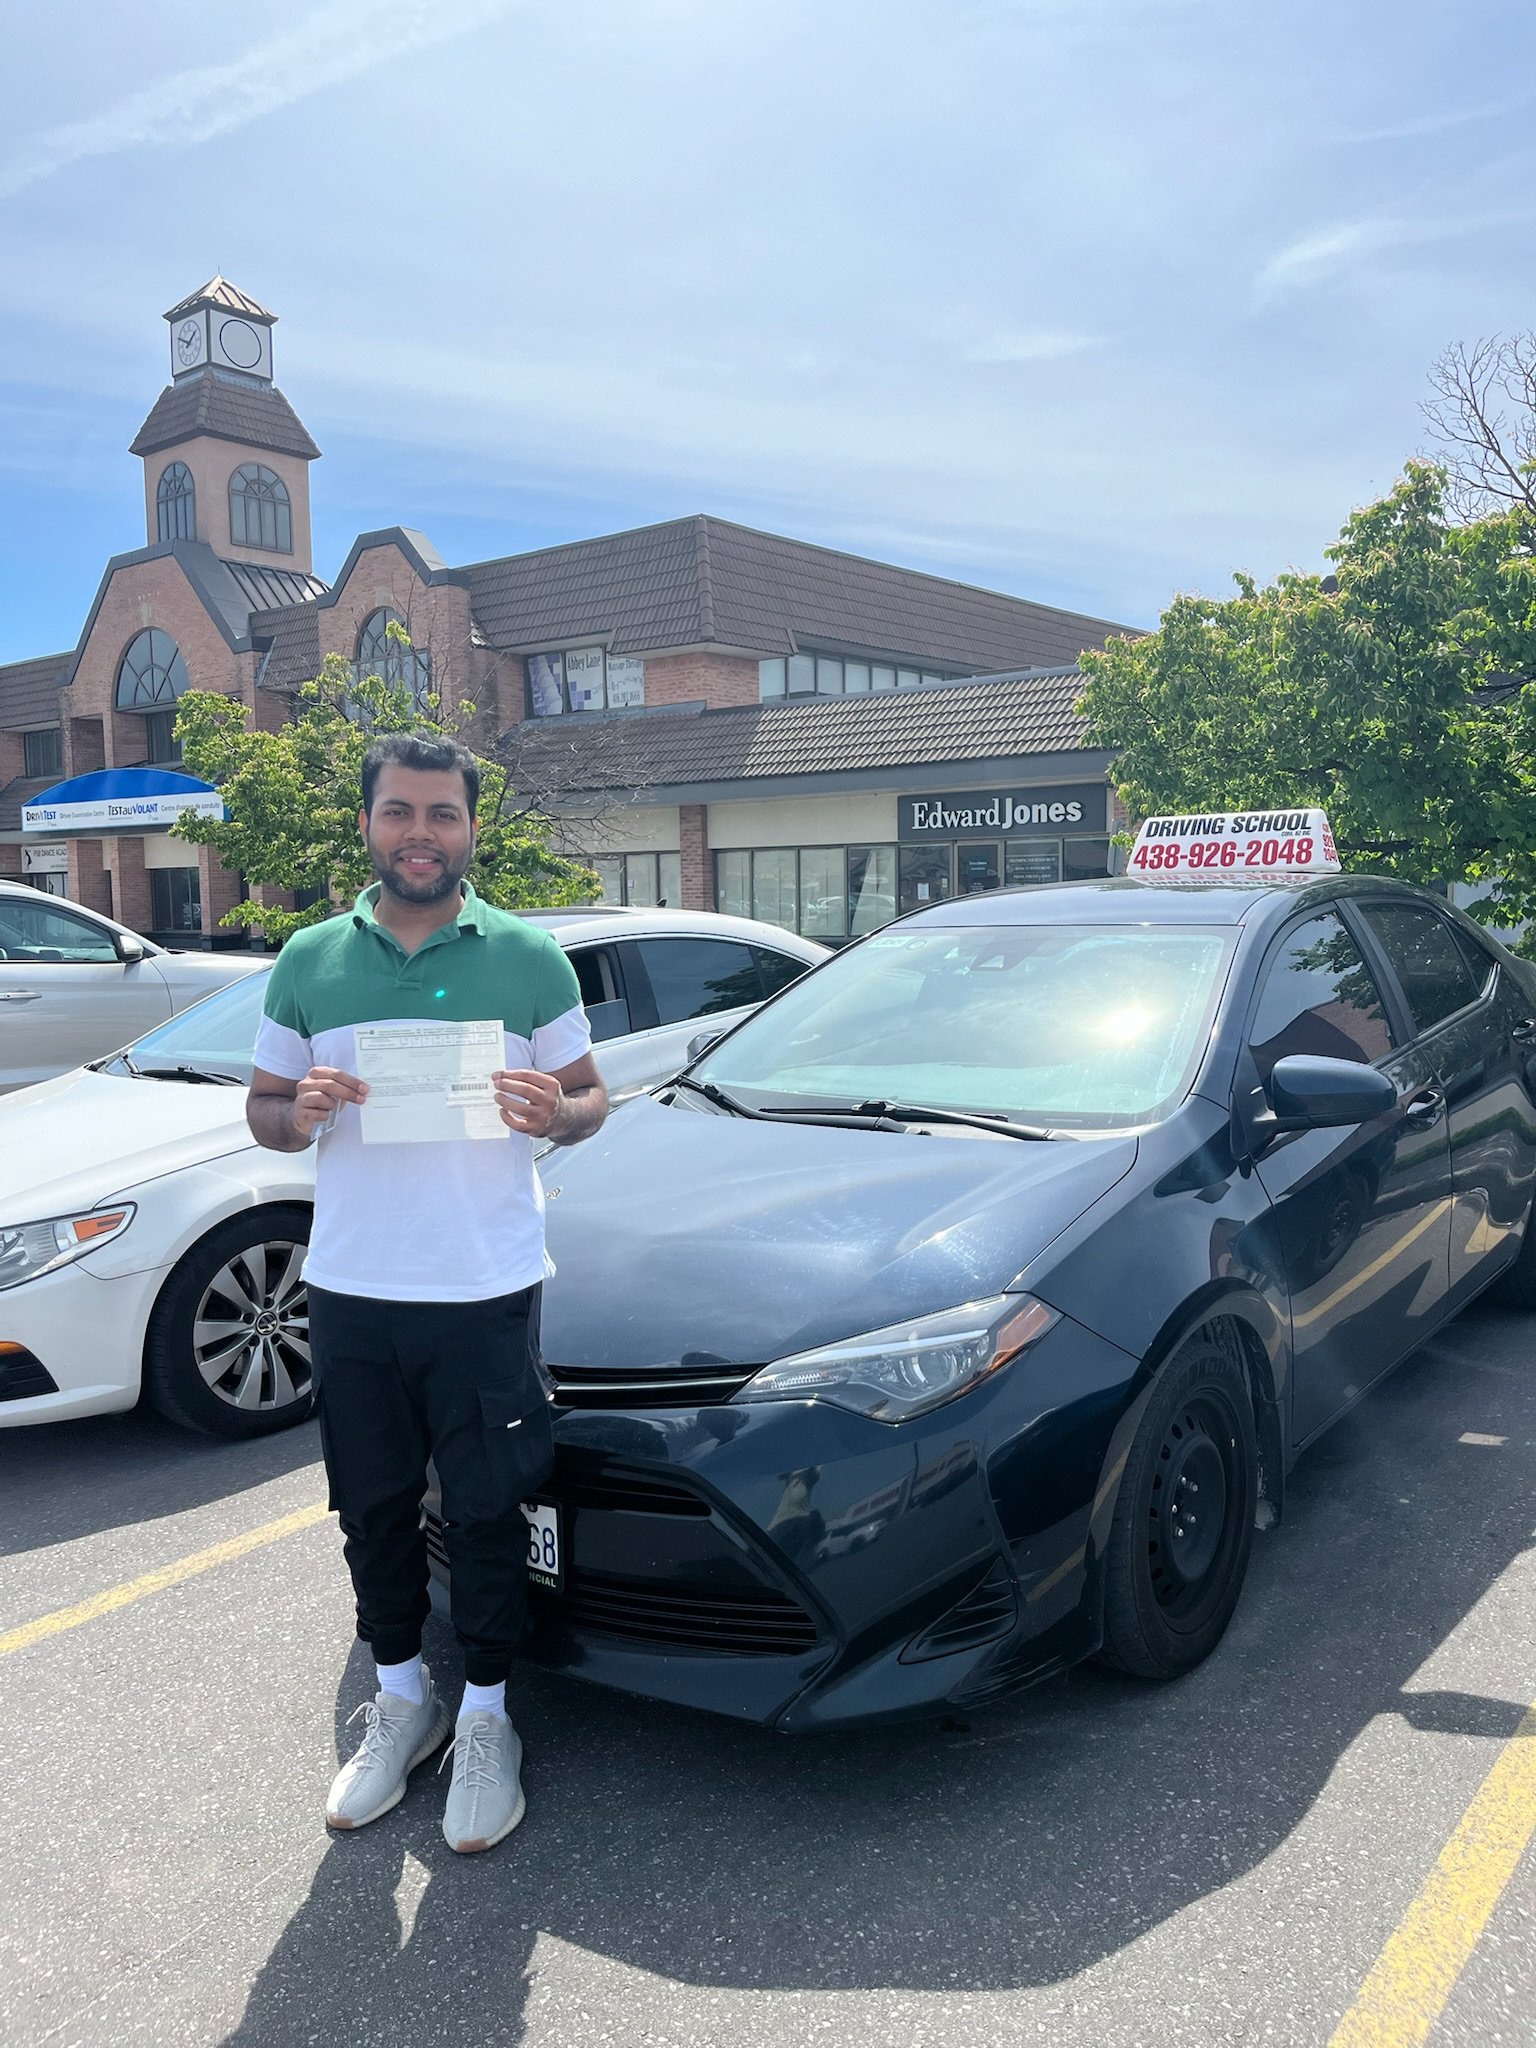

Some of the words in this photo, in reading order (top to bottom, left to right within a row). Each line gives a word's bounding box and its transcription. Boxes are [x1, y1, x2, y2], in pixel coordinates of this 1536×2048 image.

[567, 656, 585, 672] Abbey
[586, 653, 601, 669] Lane
[1146, 818, 1225, 837] DRIVING
[1231, 813, 1311, 833] SCHOOL
[55, 848, 67, 856] ACAD
[1133, 838, 1313, 869] 438-926-2048
[529, 1523, 555, 1568] 68
[529, 1571, 556, 1587] NCIAL
